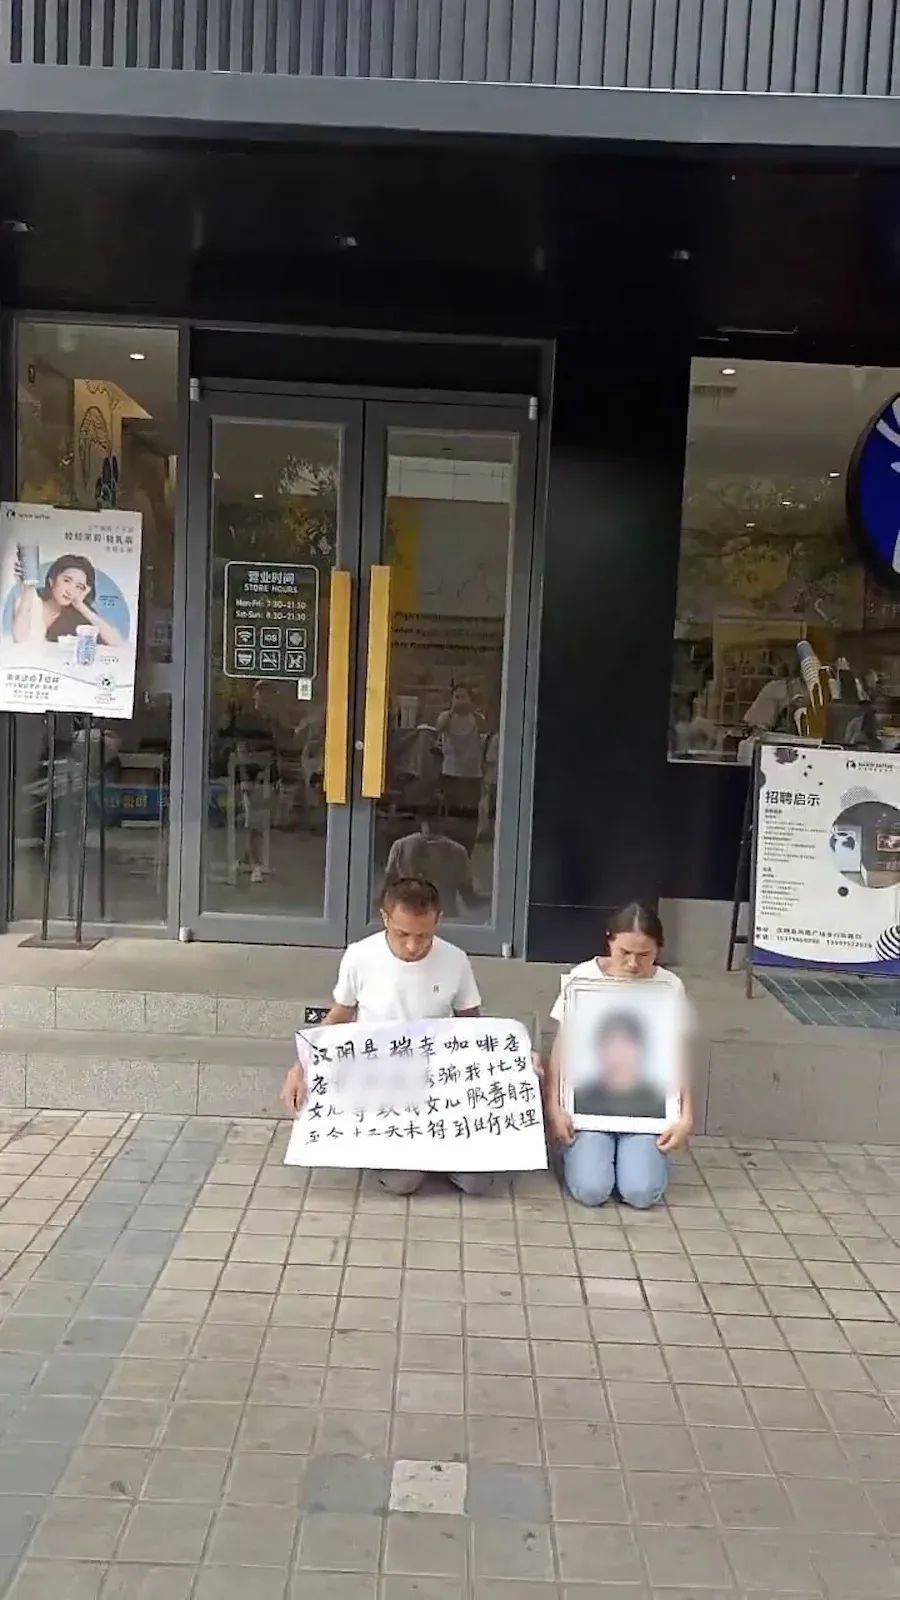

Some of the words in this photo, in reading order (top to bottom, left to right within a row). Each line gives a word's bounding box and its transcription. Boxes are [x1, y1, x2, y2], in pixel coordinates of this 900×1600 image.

[248, 571, 295, 585] 营业时间
[244, 584, 270, 592] STORE
[271, 585, 298, 594] HOURS
[765, 790, 821, 807] 招聘启示
